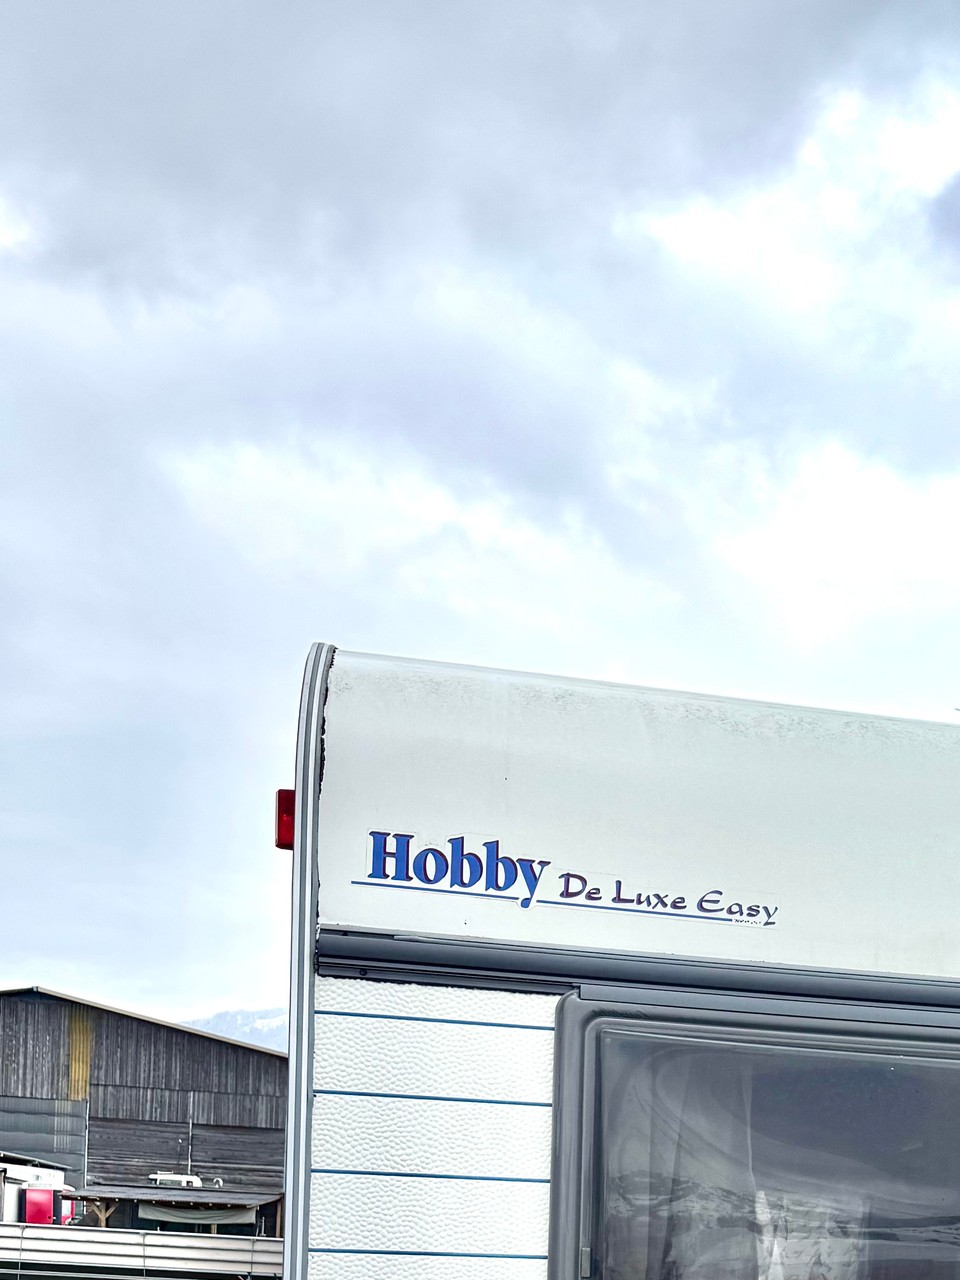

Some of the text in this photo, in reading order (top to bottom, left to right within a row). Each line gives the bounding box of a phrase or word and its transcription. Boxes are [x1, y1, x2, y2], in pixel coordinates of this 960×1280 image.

[368, 831, 551, 909] Hobby
[558, 872, 778, 926] De Luxe Easy
